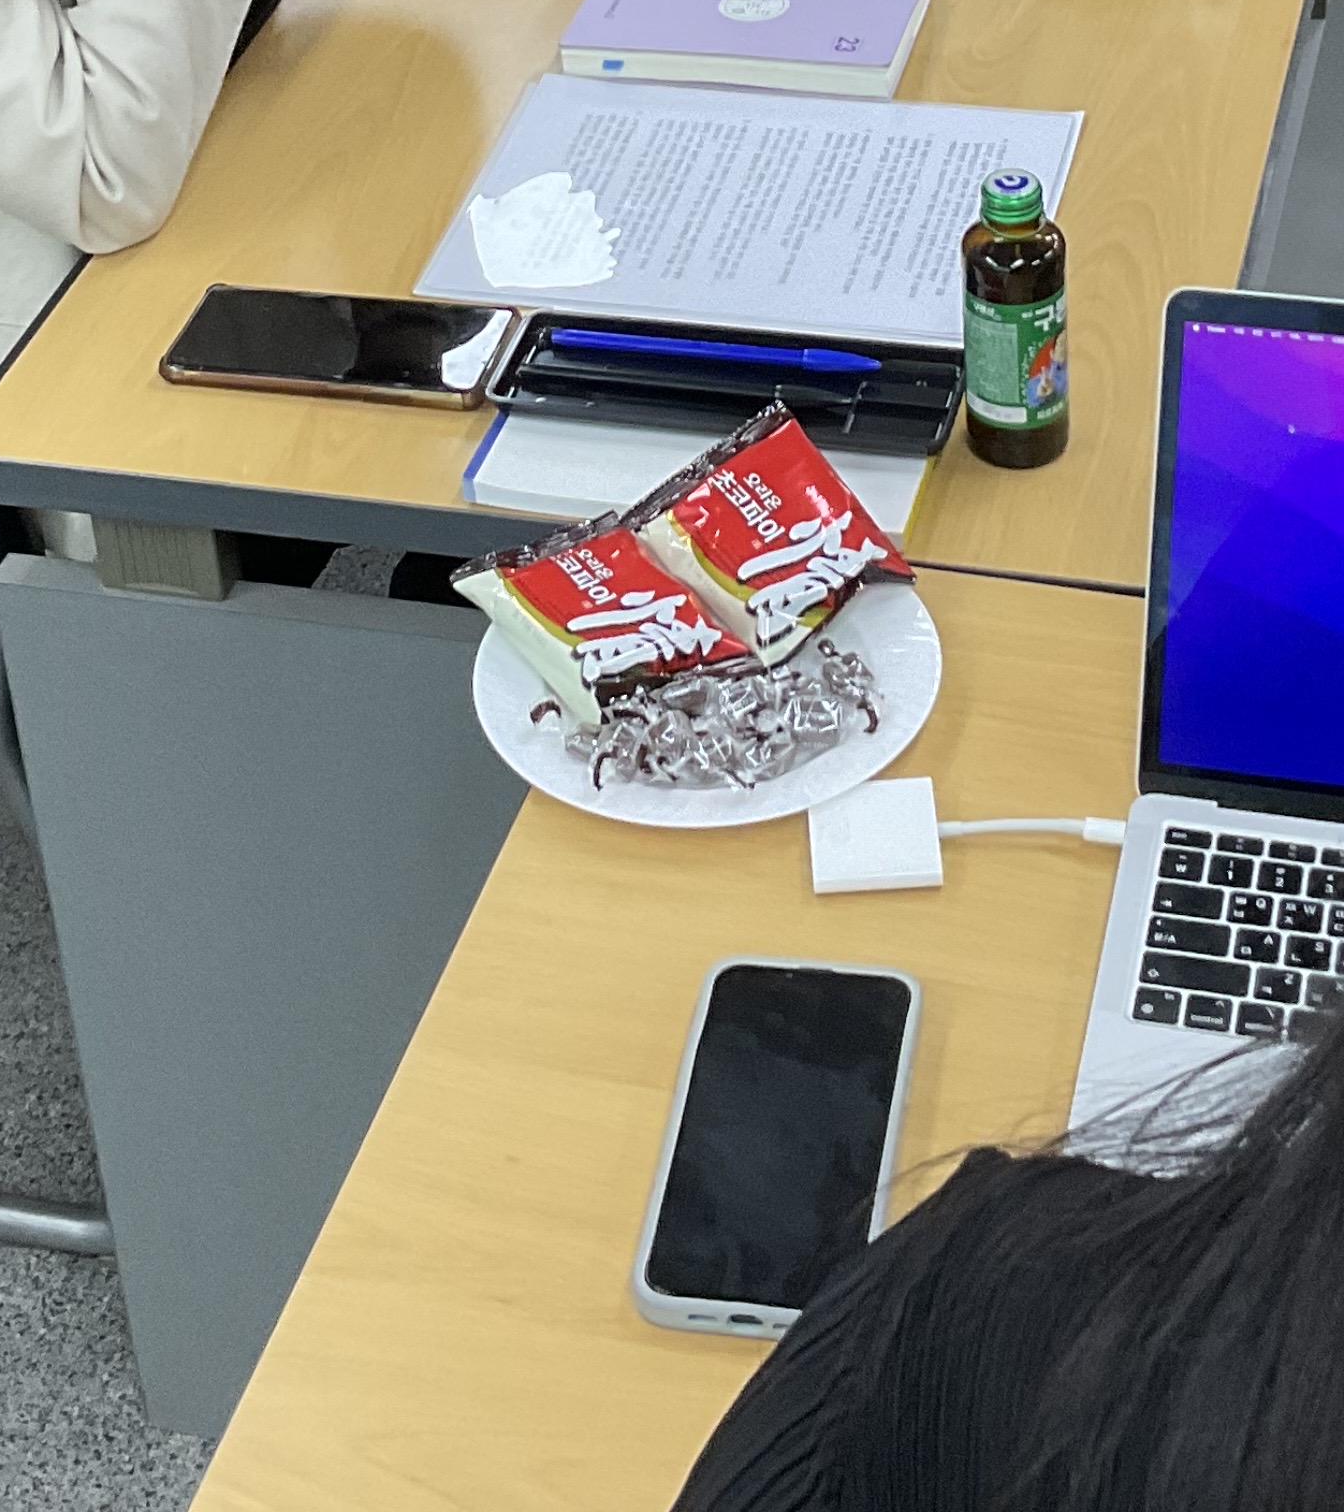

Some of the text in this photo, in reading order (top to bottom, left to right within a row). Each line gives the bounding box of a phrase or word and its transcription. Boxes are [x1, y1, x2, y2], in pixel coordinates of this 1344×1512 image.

[707, 469, 785, 543] 초코파이
[743, 472, 782, 512] 오리온
[552, 551, 617, 605] 코파이
[577, 548, 614, 580] 오리온
